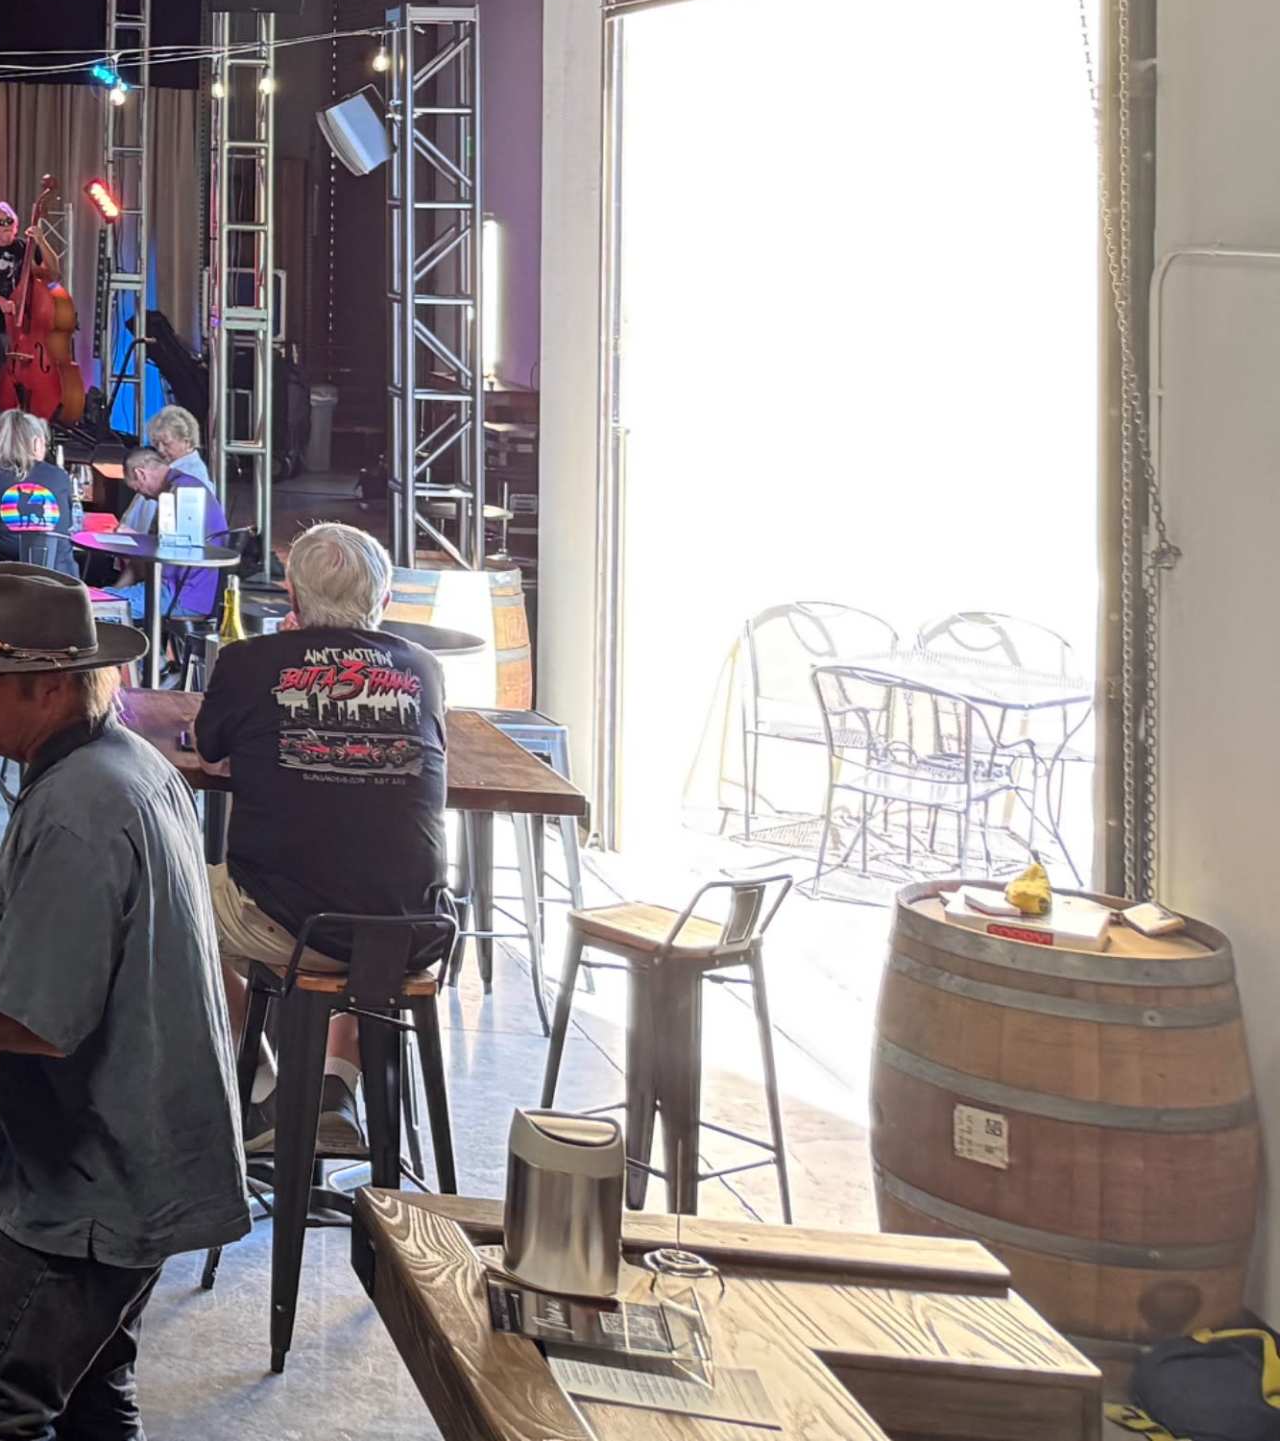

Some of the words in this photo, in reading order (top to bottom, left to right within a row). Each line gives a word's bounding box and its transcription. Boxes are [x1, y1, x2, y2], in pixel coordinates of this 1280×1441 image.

[304, 646, 341, 665] AIN'T
[280, 666, 321, 693] BUT
[327, 660, 368, 701] 3
